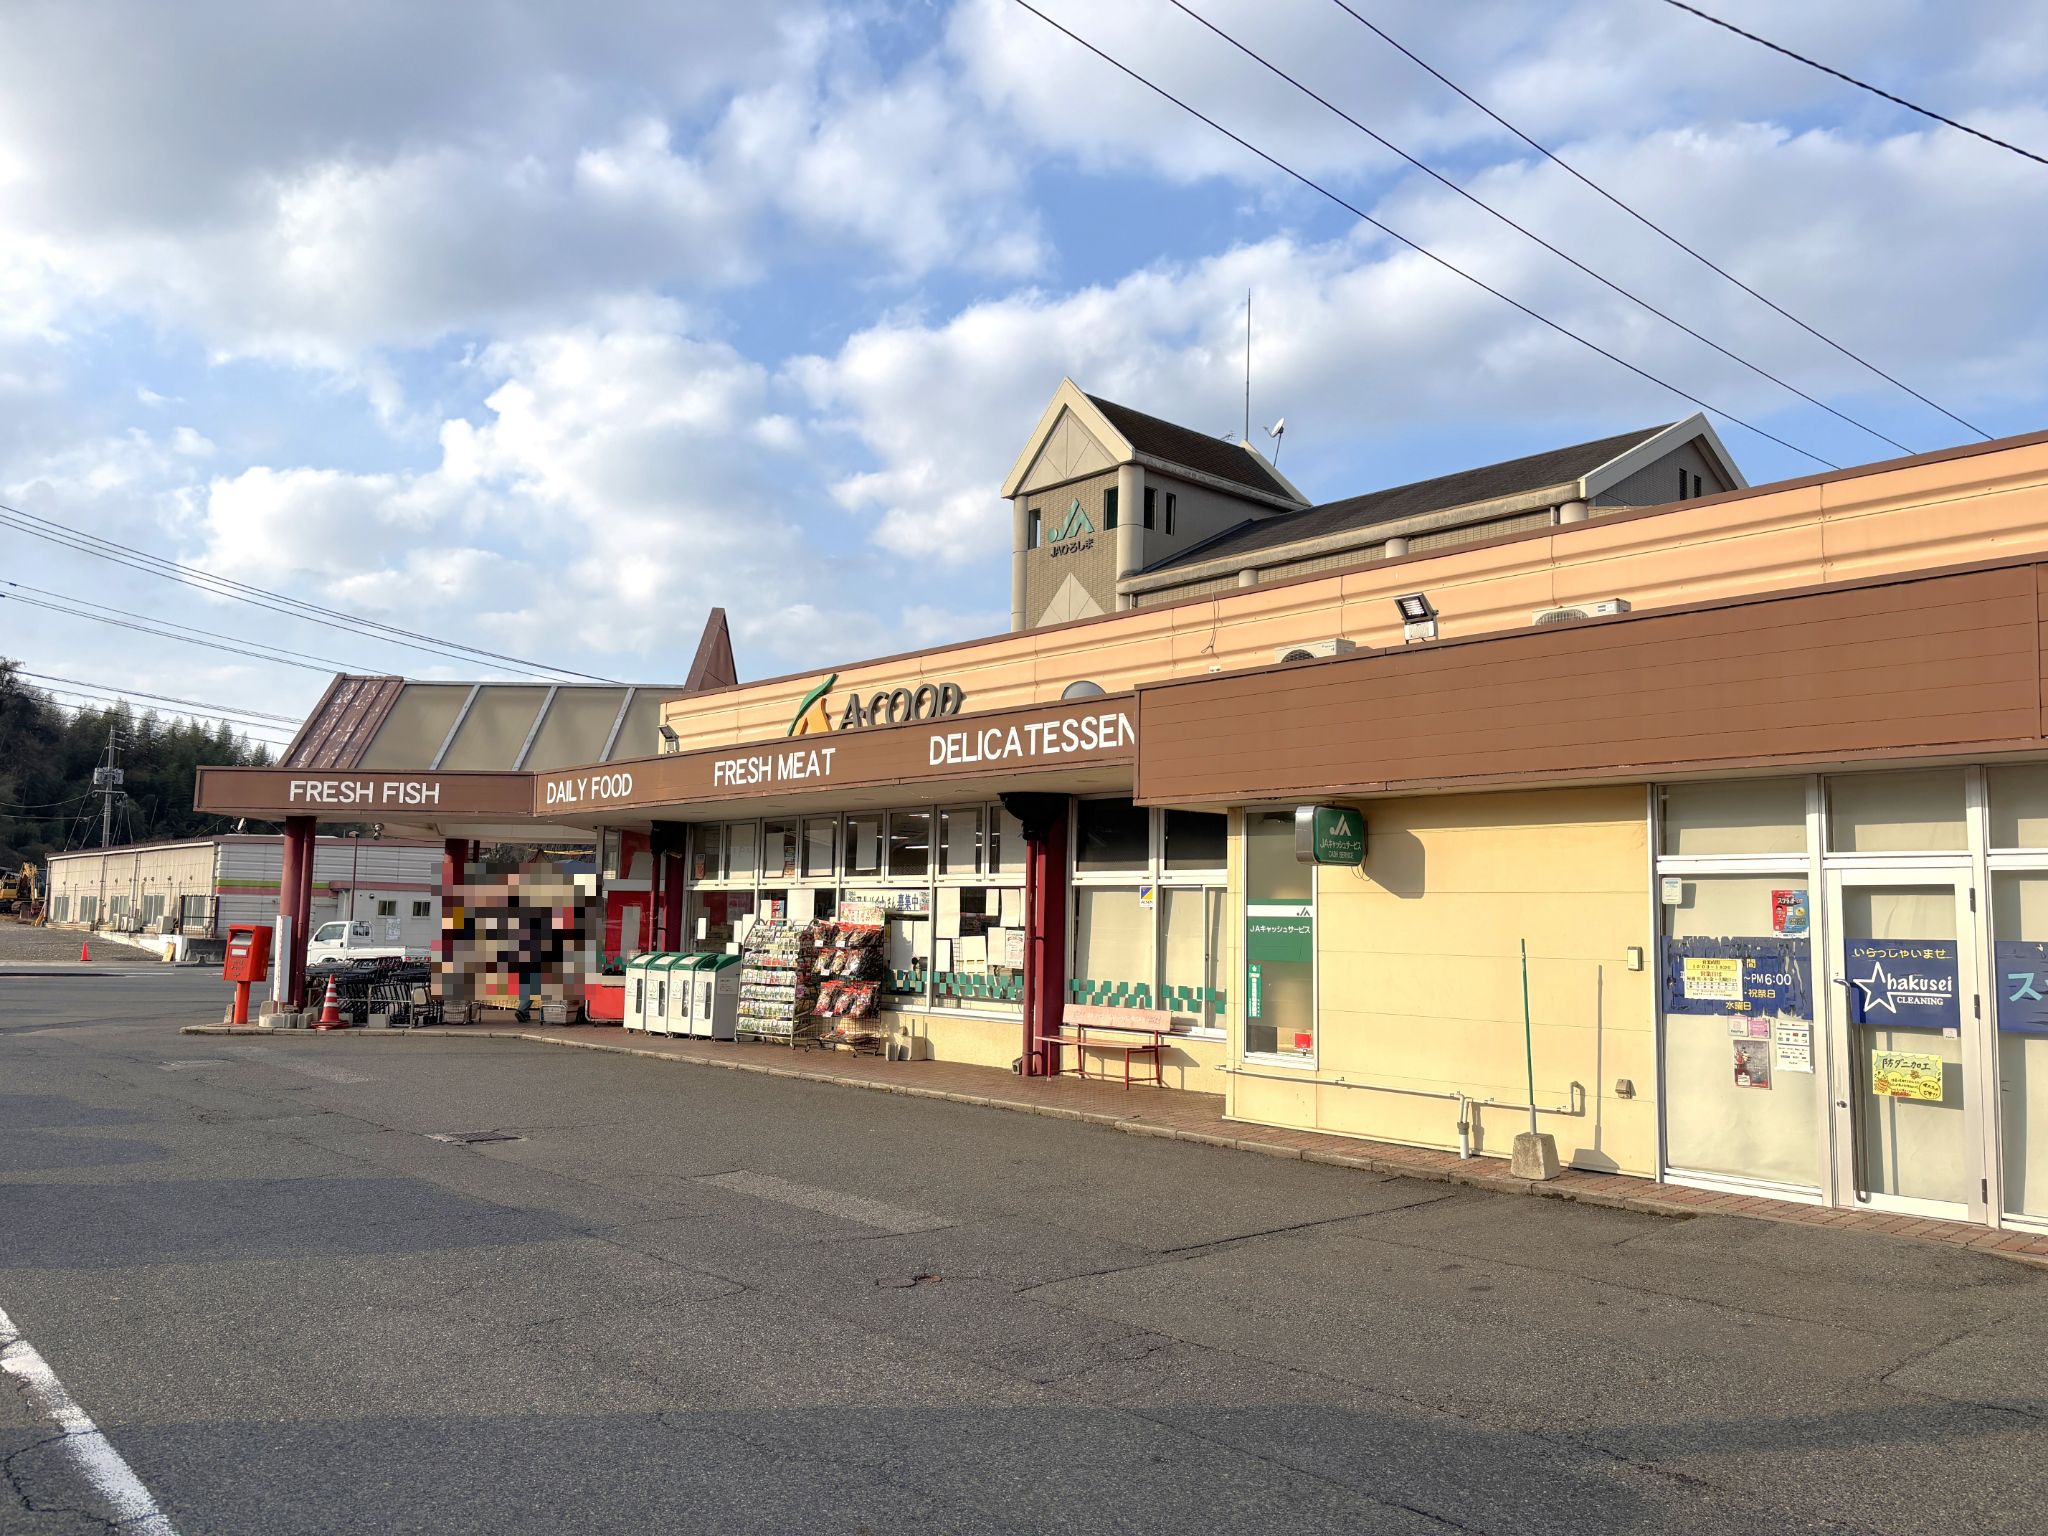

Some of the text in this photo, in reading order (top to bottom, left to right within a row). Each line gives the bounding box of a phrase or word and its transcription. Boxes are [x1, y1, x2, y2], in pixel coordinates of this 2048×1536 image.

[1051, 539, 1094, 558] JAひろしま
[929, 713, 1135, 766] DELICATESSEN
[714, 748, 836, 787] FRESH MEAT
[289, 780, 440, 804] FRESH FISH
[547, 773, 633, 804] DAILY FOOD
[1250, 925, 1311, 934] JAキャッシュサービス
[1854, 947, 1947, 959] いらっしゃいませ
[1887, 973, 1952, 992] hakusei
[2007, 972, 2048, 1002] ス
[1725, 1001, 1752, 1011] 水曜日
[1896, 996, 1944, 1006] CLEANING
[1882, 1058, 1931, 1070] 防ダニ加工
